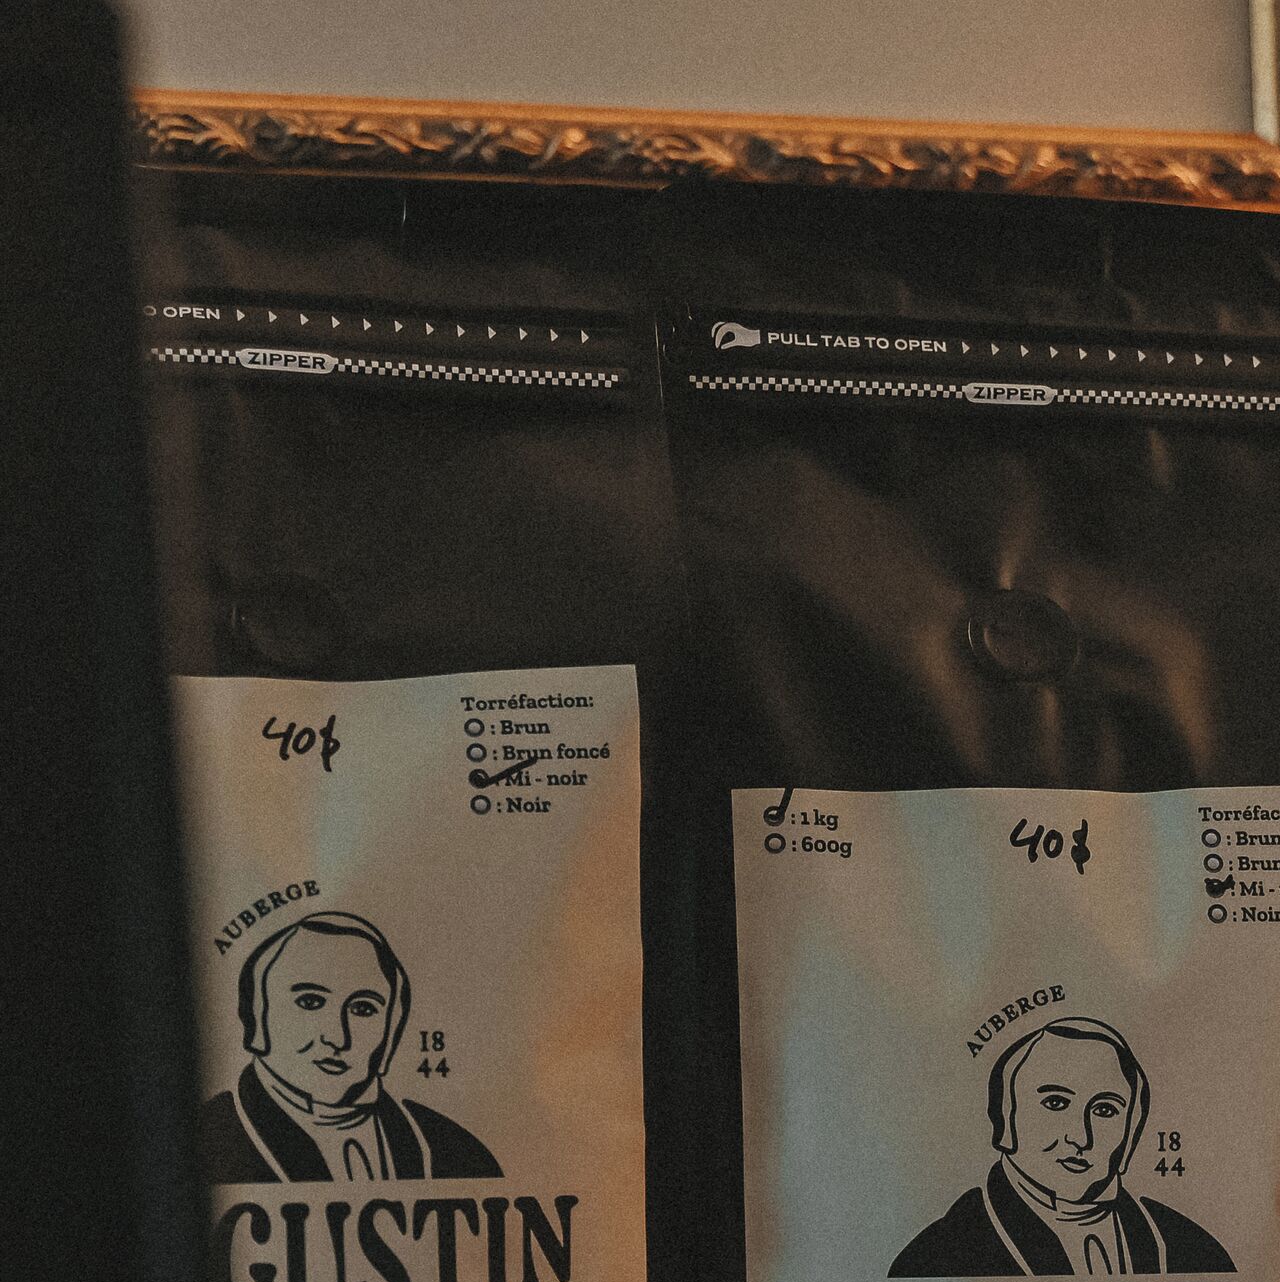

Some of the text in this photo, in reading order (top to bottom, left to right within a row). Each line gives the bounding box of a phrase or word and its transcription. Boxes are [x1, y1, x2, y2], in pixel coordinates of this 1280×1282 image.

[143, 305, 220, 320] O OPEN
[768, 332, 947, 352] PULL TAB TO OPEN
[247, 351, 326, 370] ZIPPER
[972, 386, 1047, 401] ZIPPER
[460, 693, 594, 712] Torréfaction:
[500, 719, 551, 735] Brun
[261, 714, 341, 773] 40$
[502, 745, 553, 760] Brun
[556, 742, 611, 760] foncé
[546, 770, 588, 786] noir
[506, 797, 552, 813] Noir
[801, 835, 853, 859] 600g
[1008, 818, 1091, 875] 40$
[1239, 880, 1265, 897] Mi
[213, 879, 320, 955] AUBERGE
[966, 984, 1066, 1058] AUBERGE
[419, 1030, 446, 1053] 18
[416, 1057, 451, 1079] 44
[1156, 1131, 1182, 1153] 18
[1153, 1155, 1186, 1178] 44
